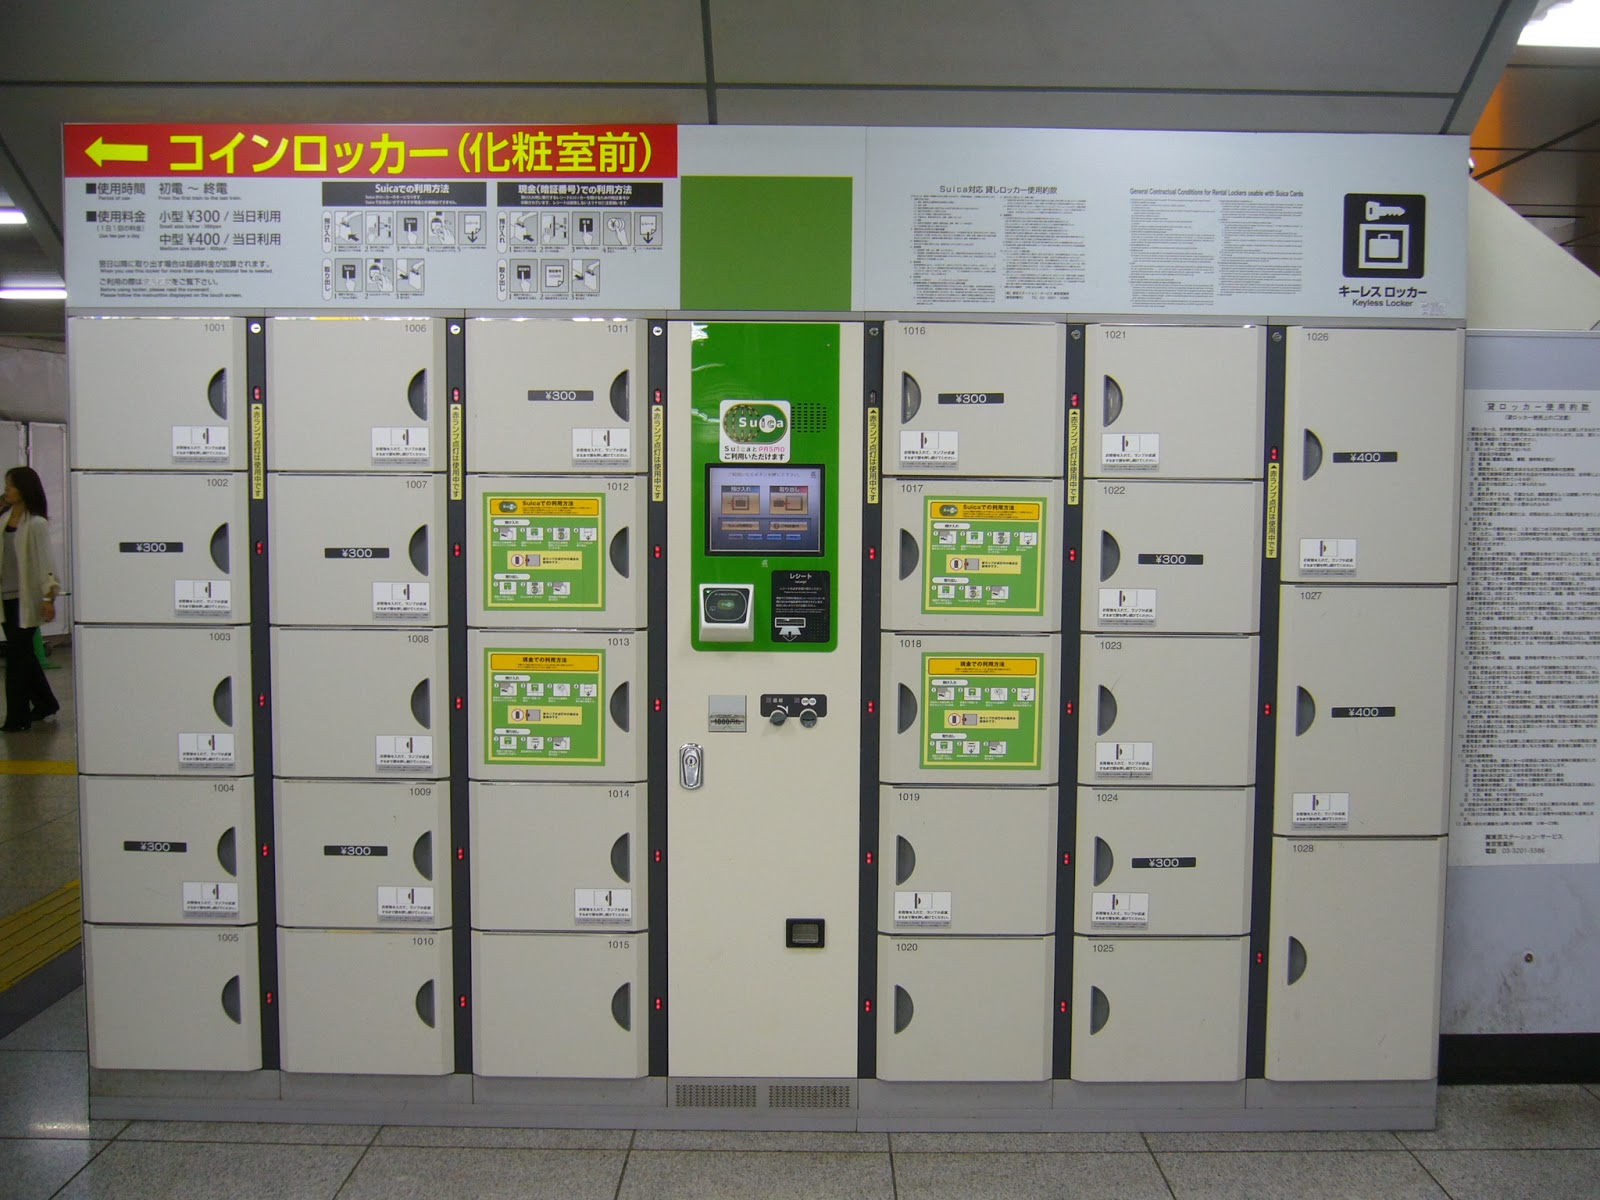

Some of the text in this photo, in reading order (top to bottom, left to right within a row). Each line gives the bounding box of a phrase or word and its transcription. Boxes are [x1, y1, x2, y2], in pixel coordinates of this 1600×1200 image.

[169, 131, 652, 174] コインロッカー(化粧室前)
[97, 183, 145, 195] 使用時間
[159, 183, 183, 195] 初電
[203, 183, 228, 195] 終電
[375, 183, 450, 194] Suicaでの利用方法
[518, 184, 633, 195] 現金(暗証番号)での利用方法
[939, 185, 1058, 195] Suica対応 貸しロッカー使用約款
[1149, 188, 1177, 196] Contractual
[1177, 188, 1203, 196] Conditions
[97, 210, 146, 223] 使用料金
[159, 210, 183, 223] 小型
[187, 209, 220, 223] ¥300
[232, 210, 281, 223] 当日利用
[159, 233, 183, 246] 中型
[187, 232, 220, 246] ¥400
[232, 233, 281, 246] 当日利用
[1338, 285, 1427, 298] キーレス ロッカー
[1352, 299, 1413, 308] Keyless Locker
[204, 324, 225, 332] 1001
[405, 325, 427, 333] 1006
[608, 325, 629, 333] 1011
[904, 327, 926, 336] 1016
[1105, 331, 1126, 339] 1021
[1307, 333, 1329, 342] 1026
[545, 391, 576, 400] ¥300
[955, 394, 986, 403] ¥300
[738, 416, 784, 429] Suica
[724, 453, 785, 461] ご利用いただけます
[1349, 453, 1381, 462] ¥400
[406, 480, 427, 488] 1007
[607, 483, 628, 491] 1012
[136, 543, 166, 552] ¥300
[342, 549, 372, 557] ¥300
[1155, 556, 1186, 564] ¥300
[789, 572, 813, 580] レシート
[210, 633, 230, 641] 1003
[408, 635, 429, 643] 1008
[1348, 708, 1379, 717] ¥400
[214, 784, 234, 792] 1004
[899, 793, 919, 801] 1019
[140, 842, 170, 851] ¥300
[340, 847, 370, 855] ¥300
[1148, 859, 1179, 867] ¥300
